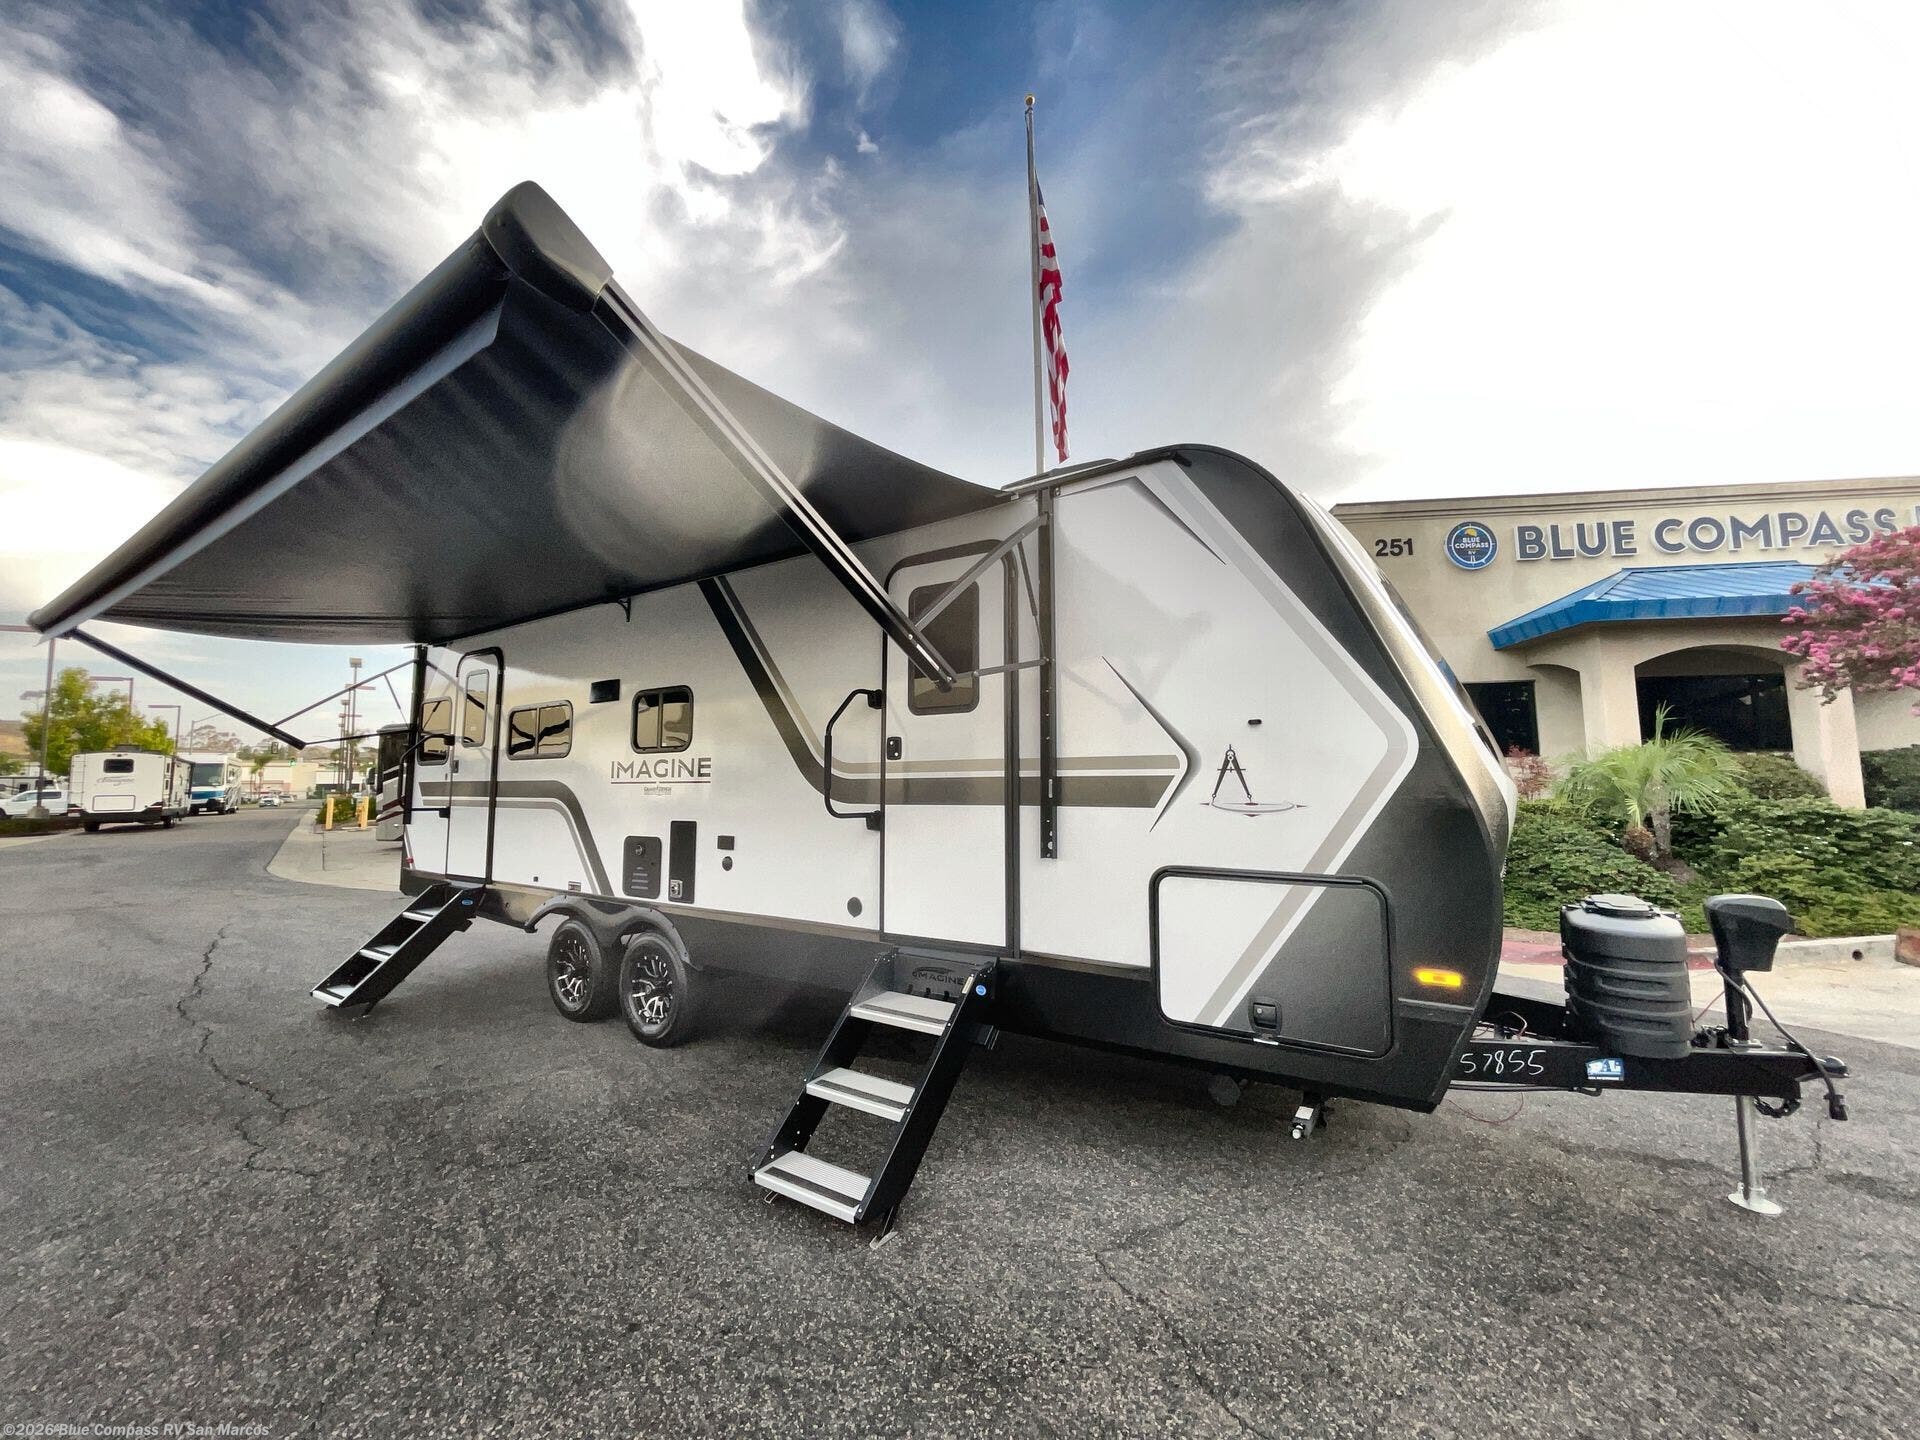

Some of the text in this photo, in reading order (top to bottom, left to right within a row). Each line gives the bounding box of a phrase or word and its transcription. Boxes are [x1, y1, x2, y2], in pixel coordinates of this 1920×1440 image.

[1515, 519, 1638, 560] BLUE
[1652, 507, 1898, 554] COMPASS
[1375, 538, 1414, 557] 251
[610, 757, 712, 779] IMAGINE
[912, 967, 966, 986] IMAGINE
[1459, 1049, 1547, 1076] 57855
